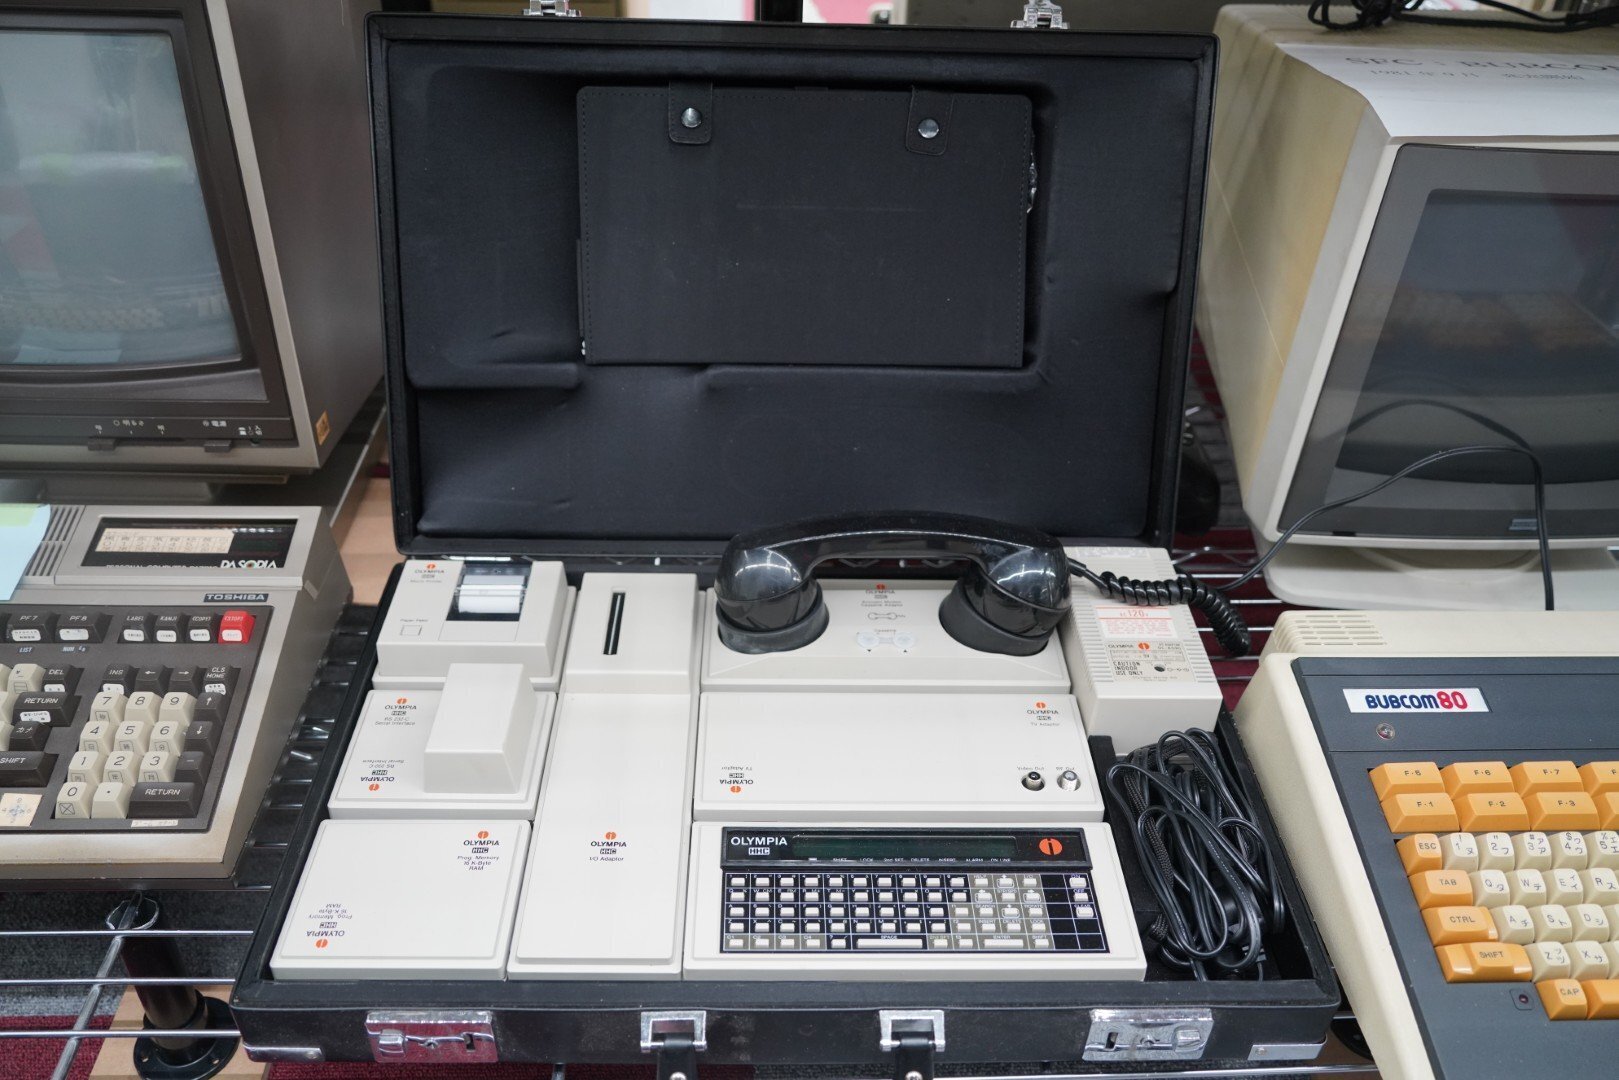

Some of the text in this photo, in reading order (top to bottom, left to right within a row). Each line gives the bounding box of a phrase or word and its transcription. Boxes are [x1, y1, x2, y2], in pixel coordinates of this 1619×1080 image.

[206, 593, 266, 602] TOSHIBA
[24, 697, 59, 705] RETURN
[103, 696, 112, 706] 7
[135, 696, 145, 706] 8
[169, 696, 180, 706] 9
[1365, 691, 1468, 710] BUBCOM80
[89, 726, 100, 735] 4
[124, 725, 136, 736] 5
[159, 725, 170, 736] 6
[0, 757, 26, 765] SHIFT
[80, 756, 87, 766] 1
[113, 756, 125, 766] 2
[149, 756, 161, 766] 3
[67, 786, 78, 797] 0
[145, 788, 181, 796] RETURN
[731, 836, 787, 846] OLYMPIA
[1418, 842, 1437, 850] ESC
[1490, 842, 1498, 851] 2
[1527, 842, 1535, 850] 3
[748, 847, 770, 855] HHC
[1485, 879, 1492, 887] Q
[1594, 878, 1602, 886] R
[1583, 914, 1591, 922] D
[1479, 951, 1504, 959] SHIFT
[1545, 952, 1552, 960] Z
